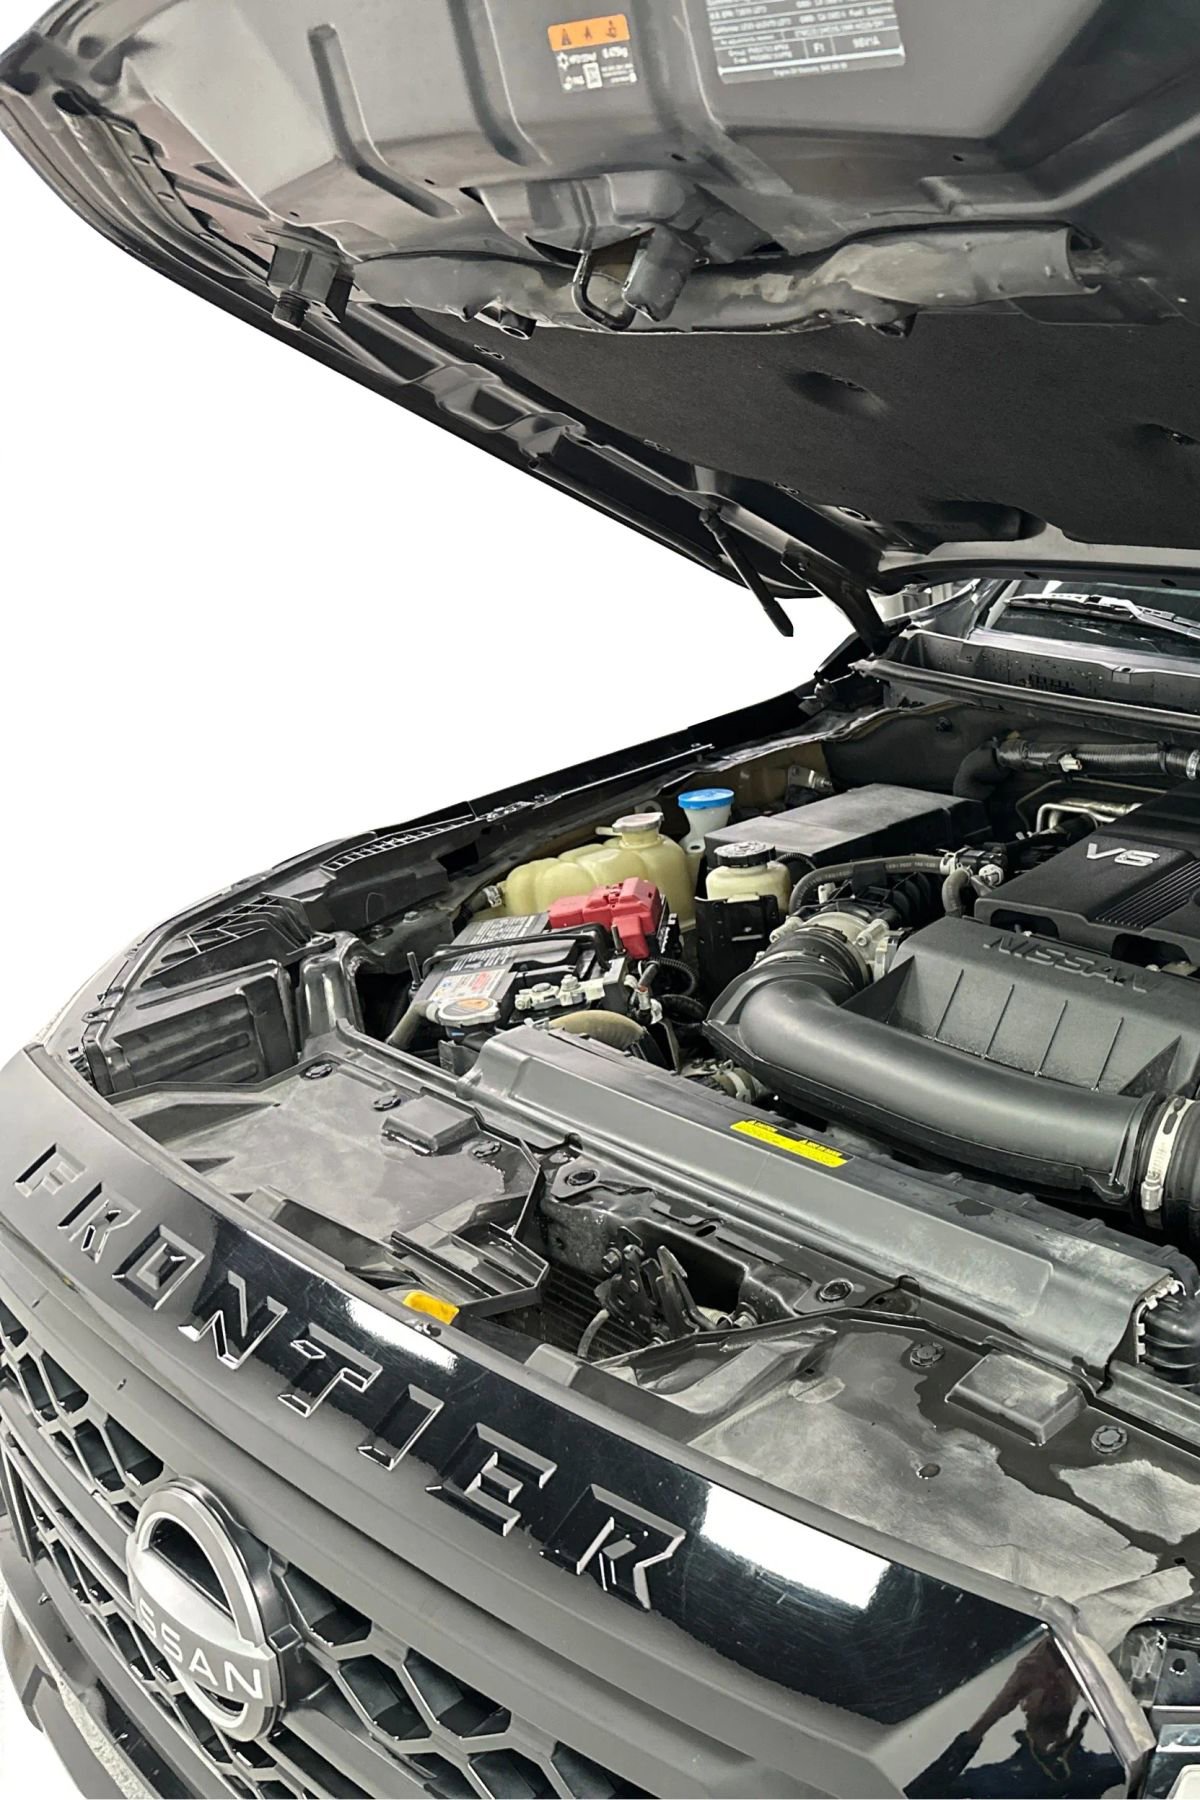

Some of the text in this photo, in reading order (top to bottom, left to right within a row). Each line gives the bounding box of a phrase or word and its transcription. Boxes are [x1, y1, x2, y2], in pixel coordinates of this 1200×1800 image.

[1086, 842, 1161, 867] V6
[982, 935, 1158, 994] NISSAN
[14, 1141, 687, 1612] FRONTIER
[137, 1596, 263, 1700] SSAN
